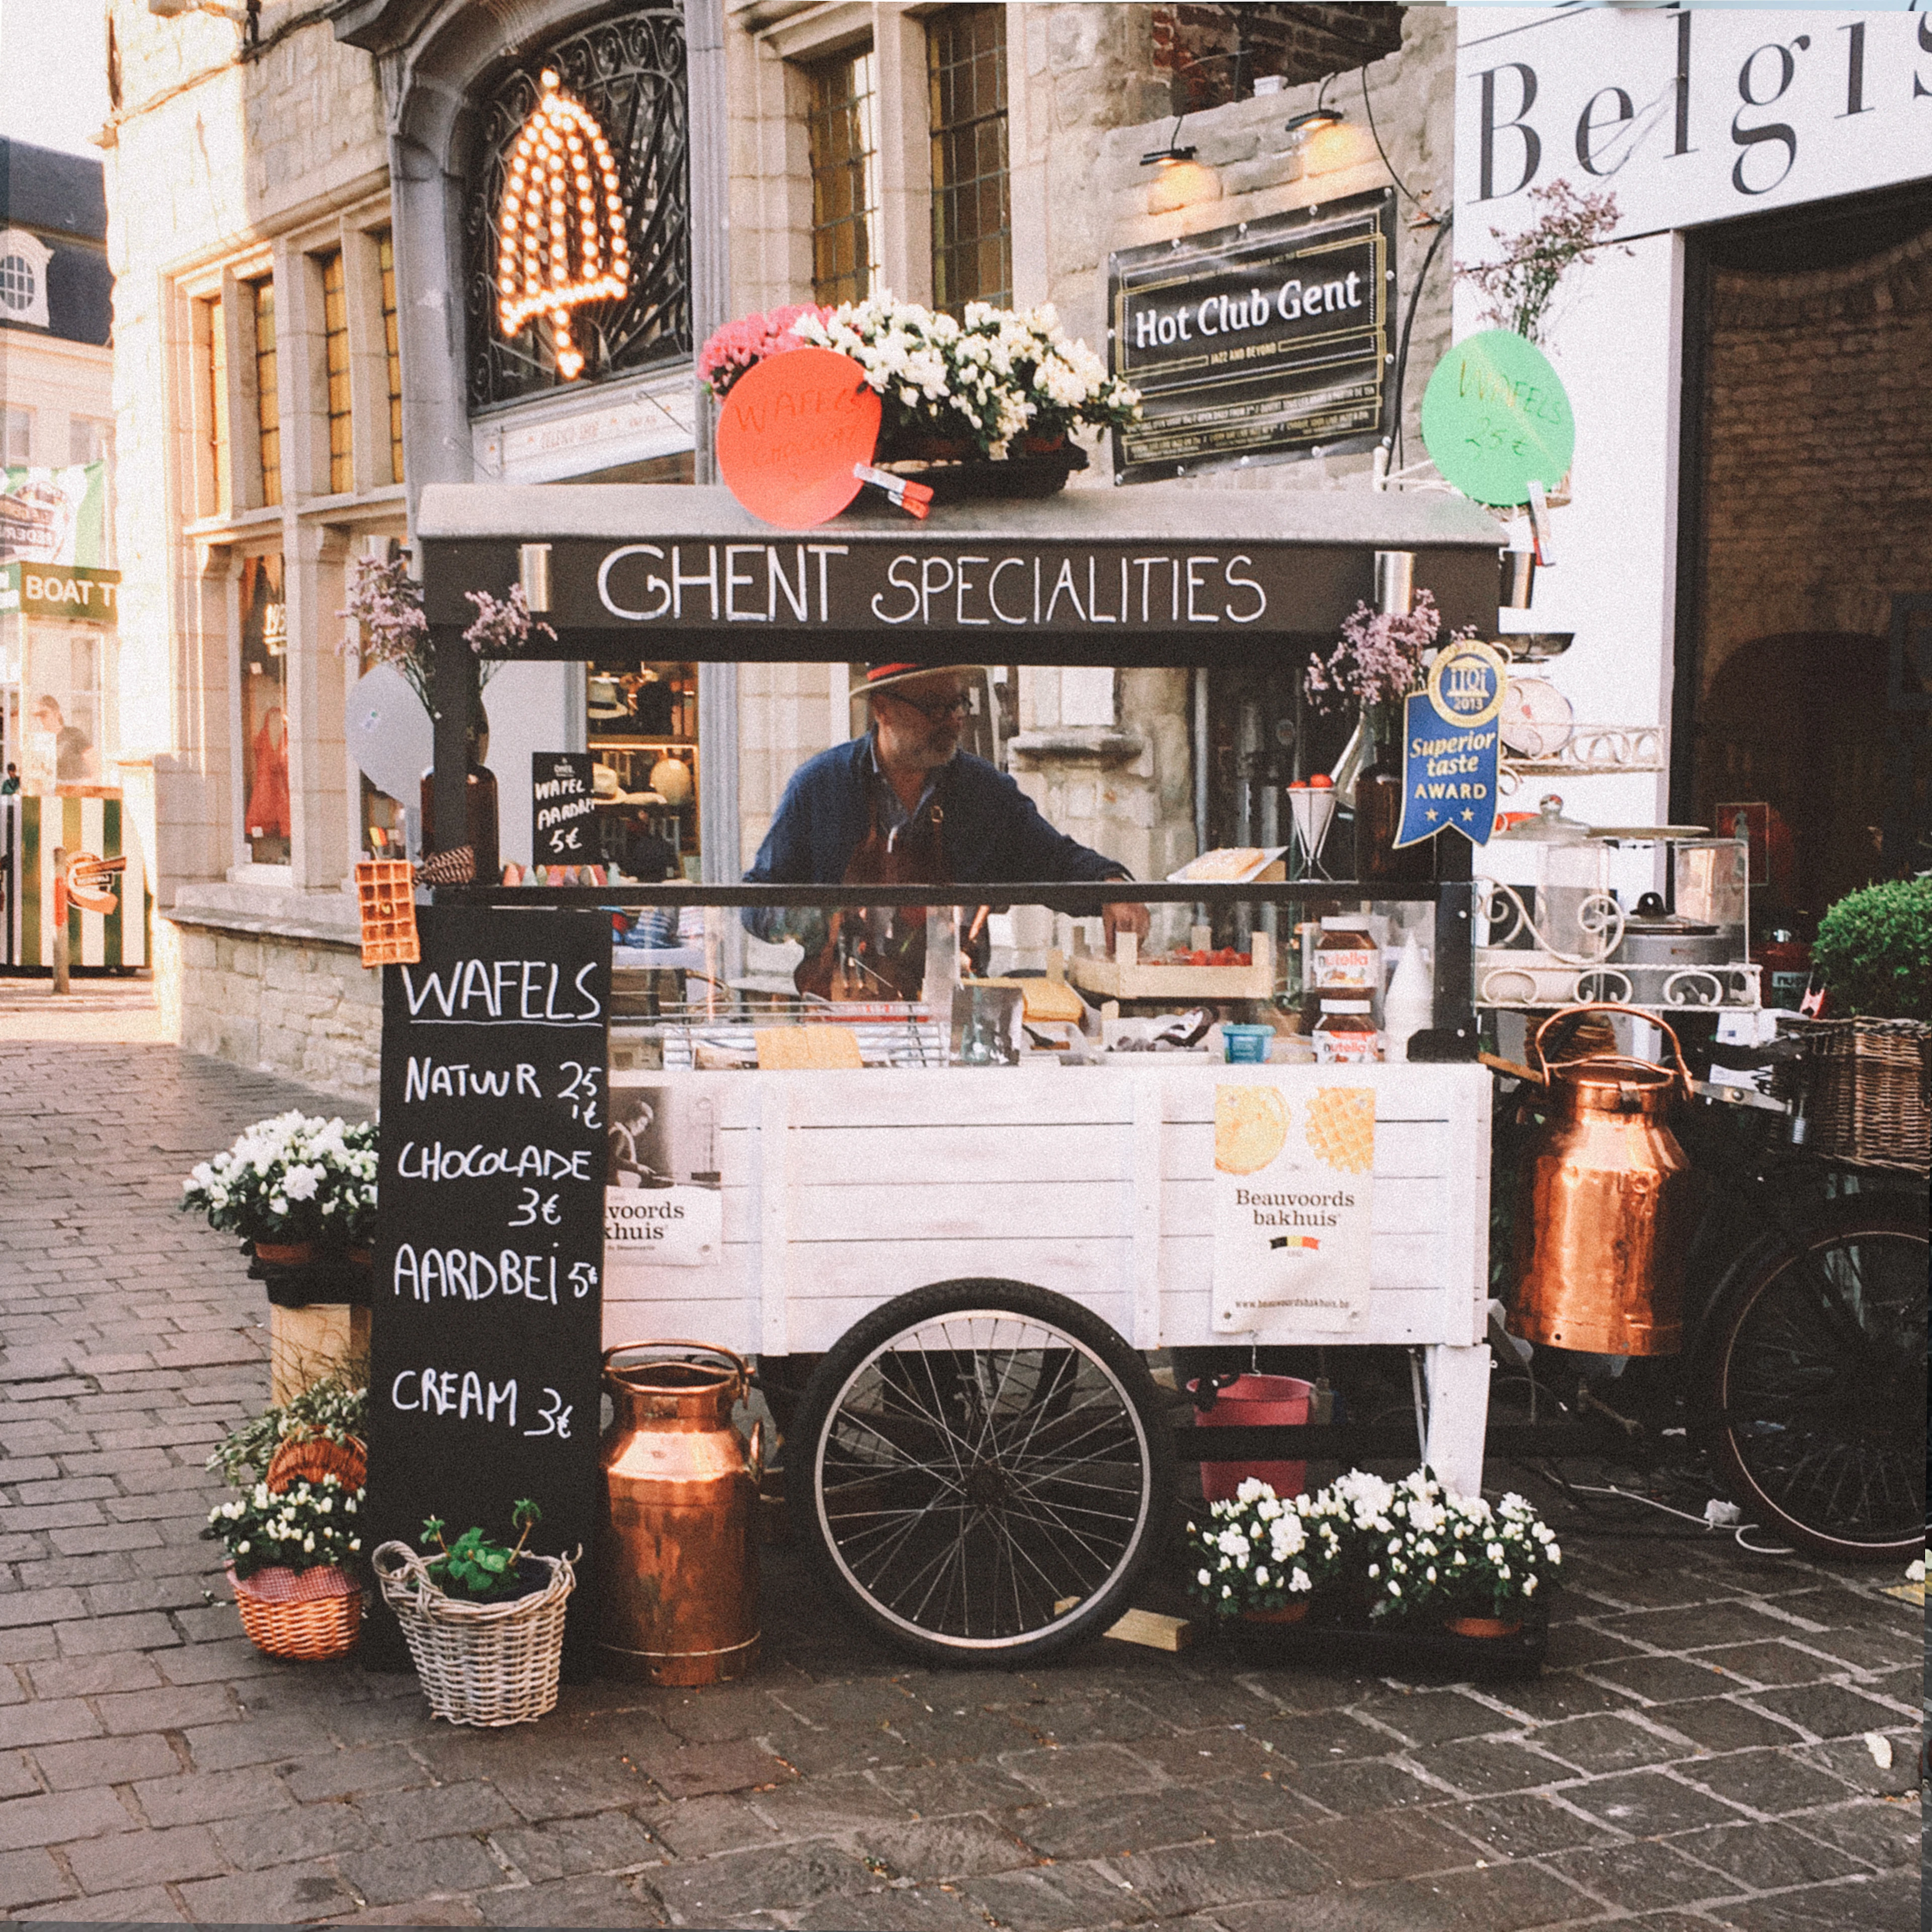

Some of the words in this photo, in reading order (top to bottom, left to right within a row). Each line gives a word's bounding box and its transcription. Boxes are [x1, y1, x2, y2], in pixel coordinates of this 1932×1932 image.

[1136, 306, 1192, 348] Hot
[1198, 289, 1270, 336] Club
[1277, 271, 1361, 321] Gent
[26, 574, 95, 605] BOAT
[597, 544, 849, 622] GHENT
[871, 555, 1266, 624] SPECIALITIES
[1454, 697, 1483, 710] 2013
[1410, 730, 1496, 759] Superior
[1427, 754, 1479, 777] taste
[1414, 783, 1487, 800] AWARD
[549, 827, 583, 853] 5€
[1318, 951, 1369, 967] nutella
[401, 958, 601, 1020] WAFELS
[1324, 1041, 1366, 1054] nutella
[398, 1141, 592, 1182] CHOCOLADE
[508, 1187, 561, 1227] 3€
[1236, 1188, 1355, 1207] Beauvoords
[1253, 1210, 1337, 1227] bakhuis
[392, 1367, 517, 1427] CREAM
[524, 1388, 573, 1438] 3€
